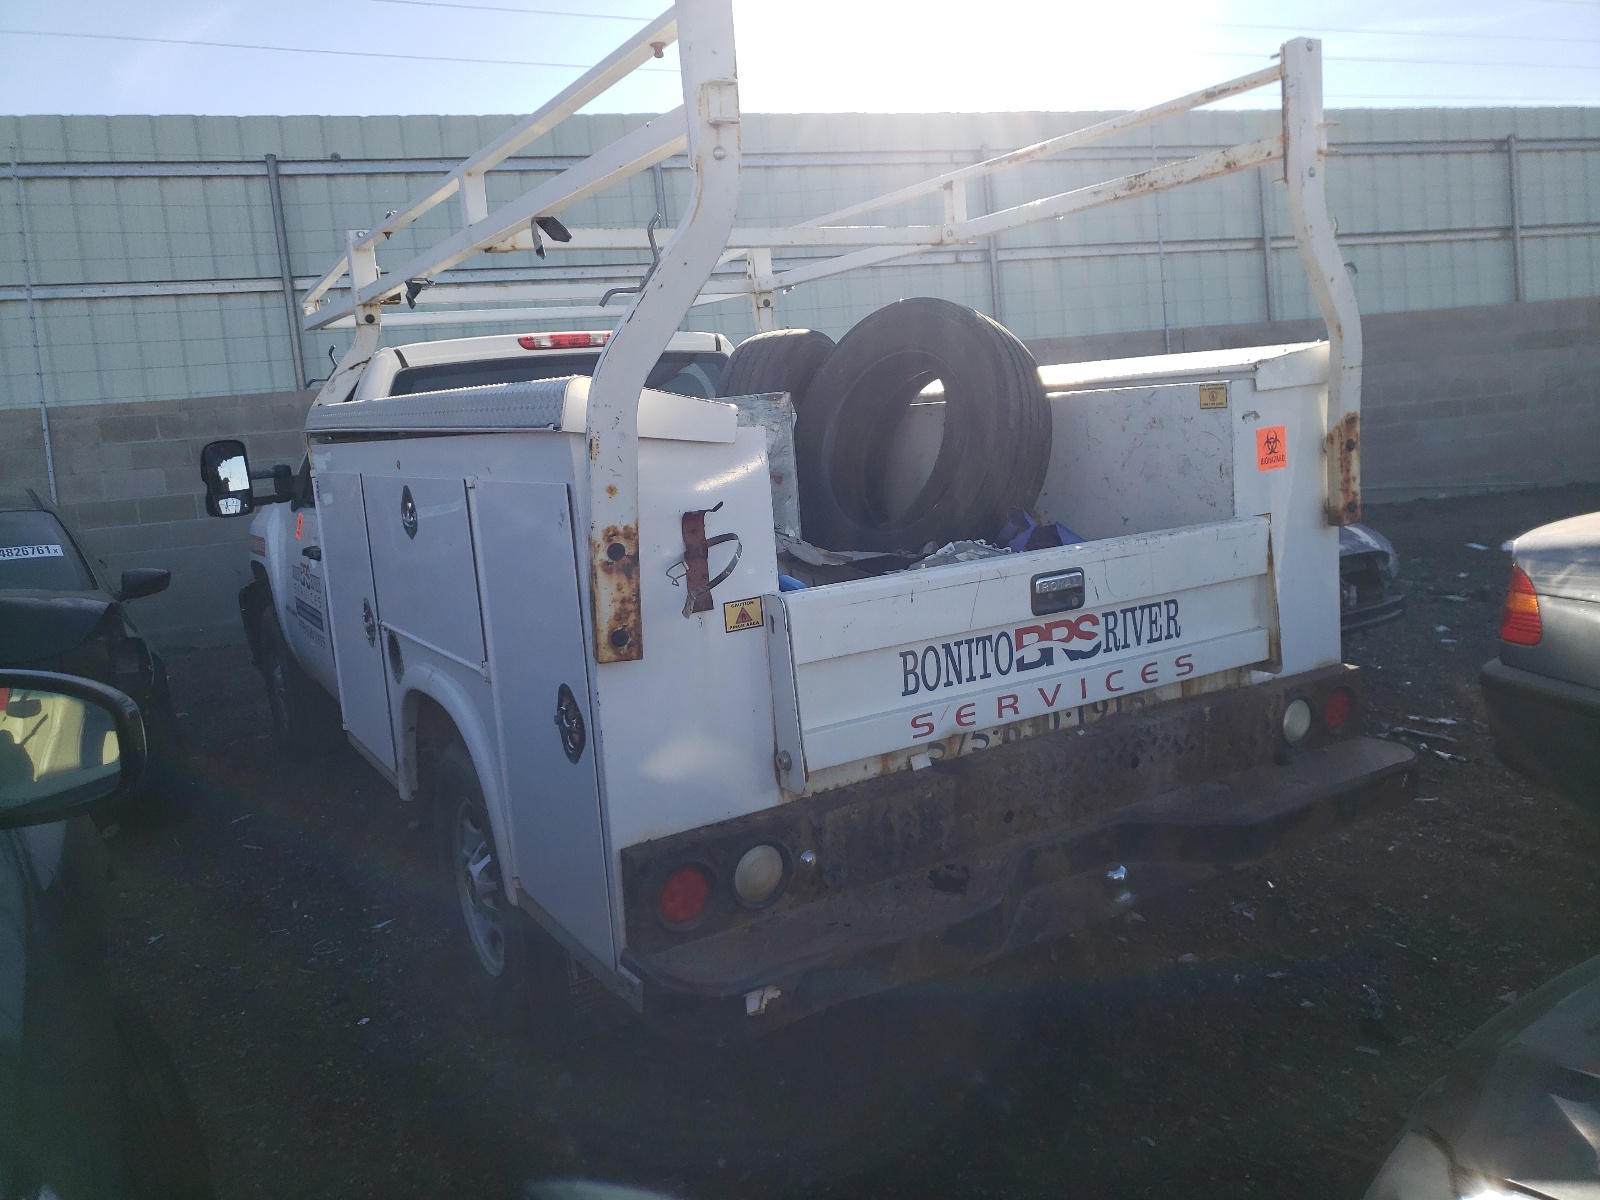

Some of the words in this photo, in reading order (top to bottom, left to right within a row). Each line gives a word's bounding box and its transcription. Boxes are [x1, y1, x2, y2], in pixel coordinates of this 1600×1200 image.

[1261, 454, 1285, 465] BIOHAZARD
[1041, 575, 1081, 592] ROYAL
[731, 600, 754, 608] CAUTION
[899, 630, 1014, 697] BONITO
[1014, 613, 1101, 673] BRS
[1102, 598, 1181, 654] RIVER
[910, 653, 1194, 739] SERVICES
